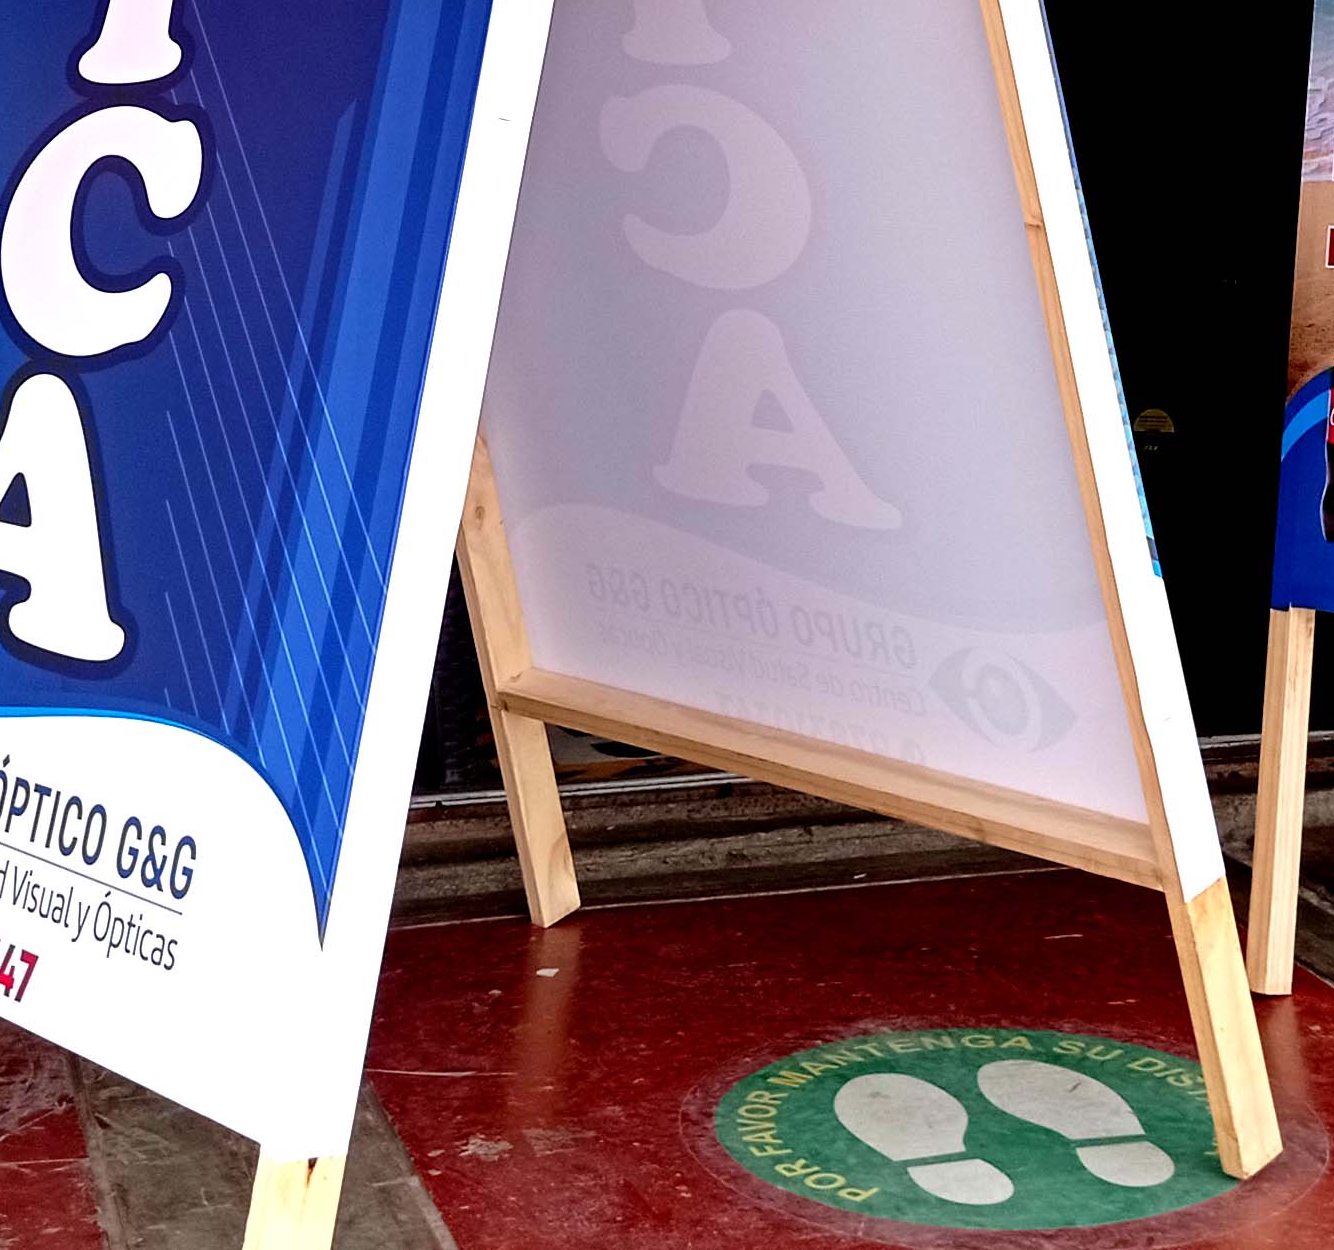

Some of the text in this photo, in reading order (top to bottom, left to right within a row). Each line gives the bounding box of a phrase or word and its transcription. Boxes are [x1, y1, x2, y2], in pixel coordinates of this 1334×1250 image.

[116, 816, 198, 900] G&G
[11, 864, 71, 930] Visual
[71, 898, 91, 943] y
[92, 890, 179, 971] Ópticas
[736, 1033, 1124, 1204] POR FAVOR MANTENGA SU
